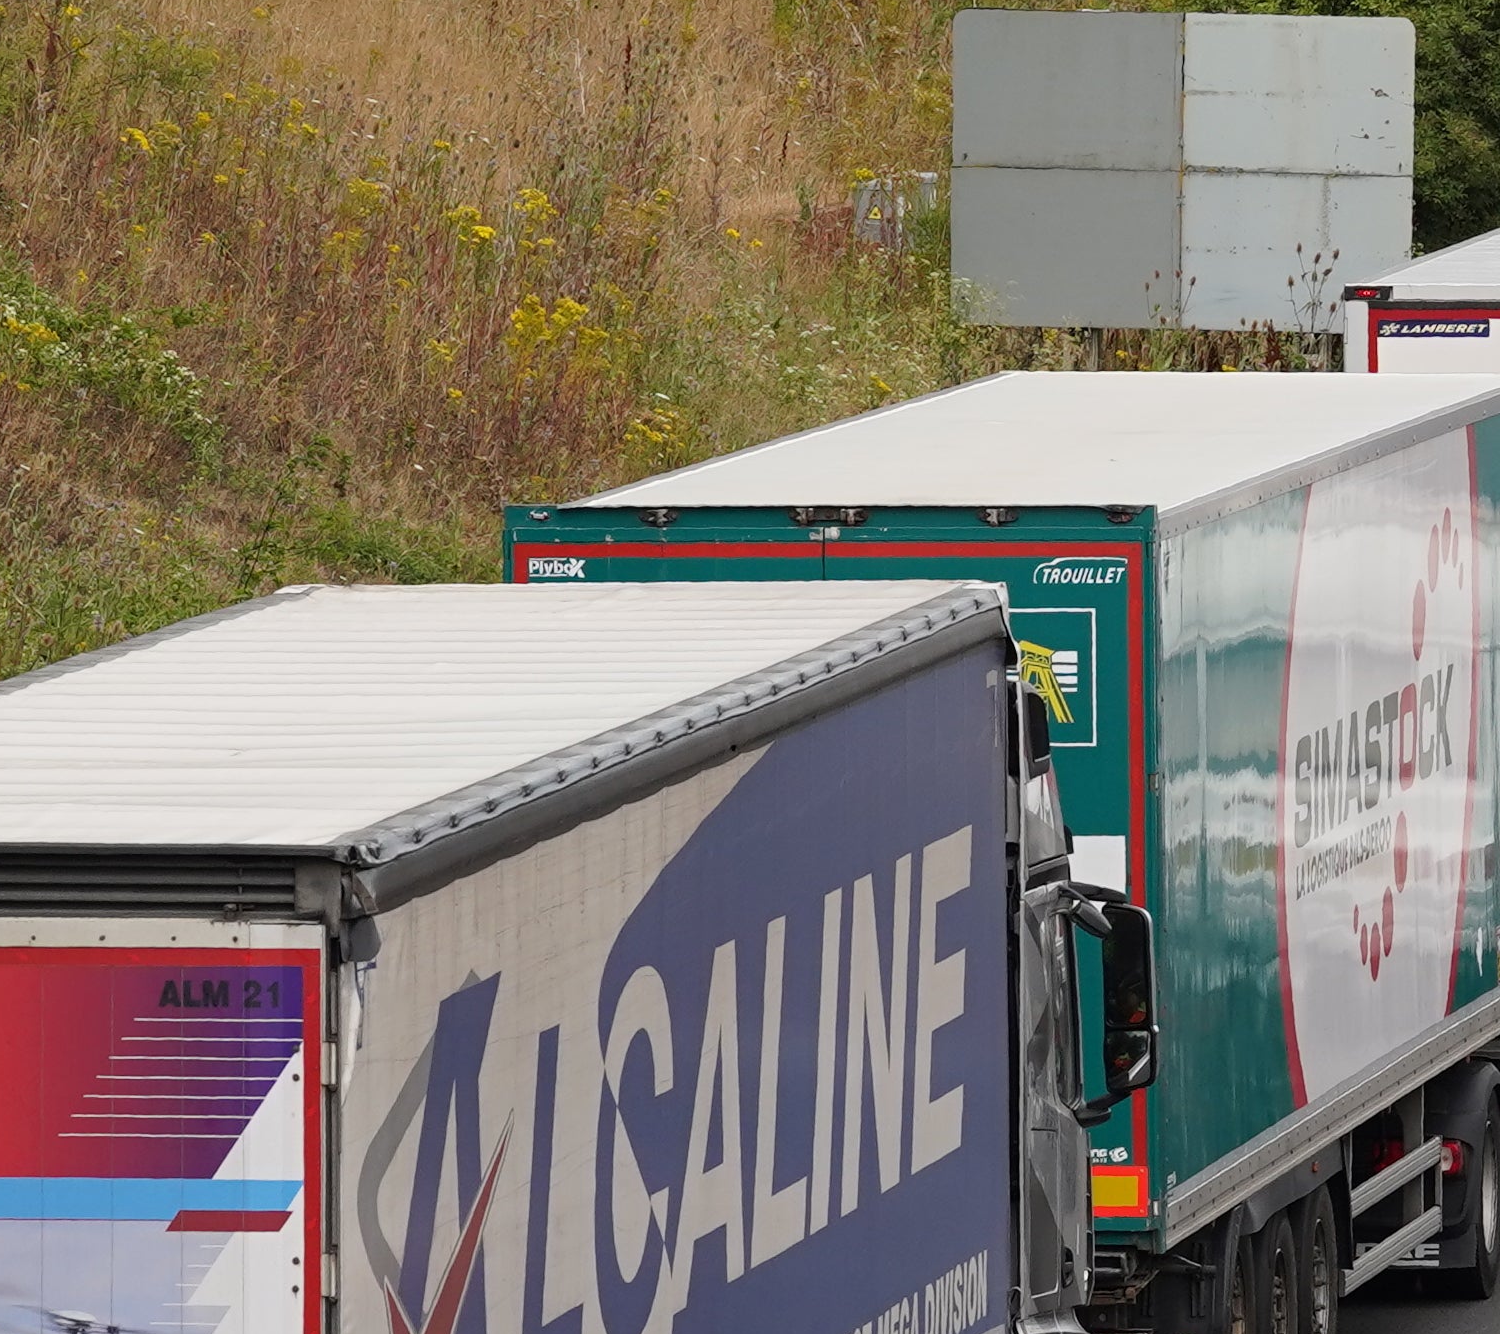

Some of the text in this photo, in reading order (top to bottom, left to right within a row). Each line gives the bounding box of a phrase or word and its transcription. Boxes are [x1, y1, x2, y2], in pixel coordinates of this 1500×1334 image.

[1401, 324, 1488, 334] LAMBERET
[1042, 567, 1126, 584] TROUILLET
[1294, 663, 1454, 849] SIMASTOCK
[158, 980, 280, 1008] ALM 21
